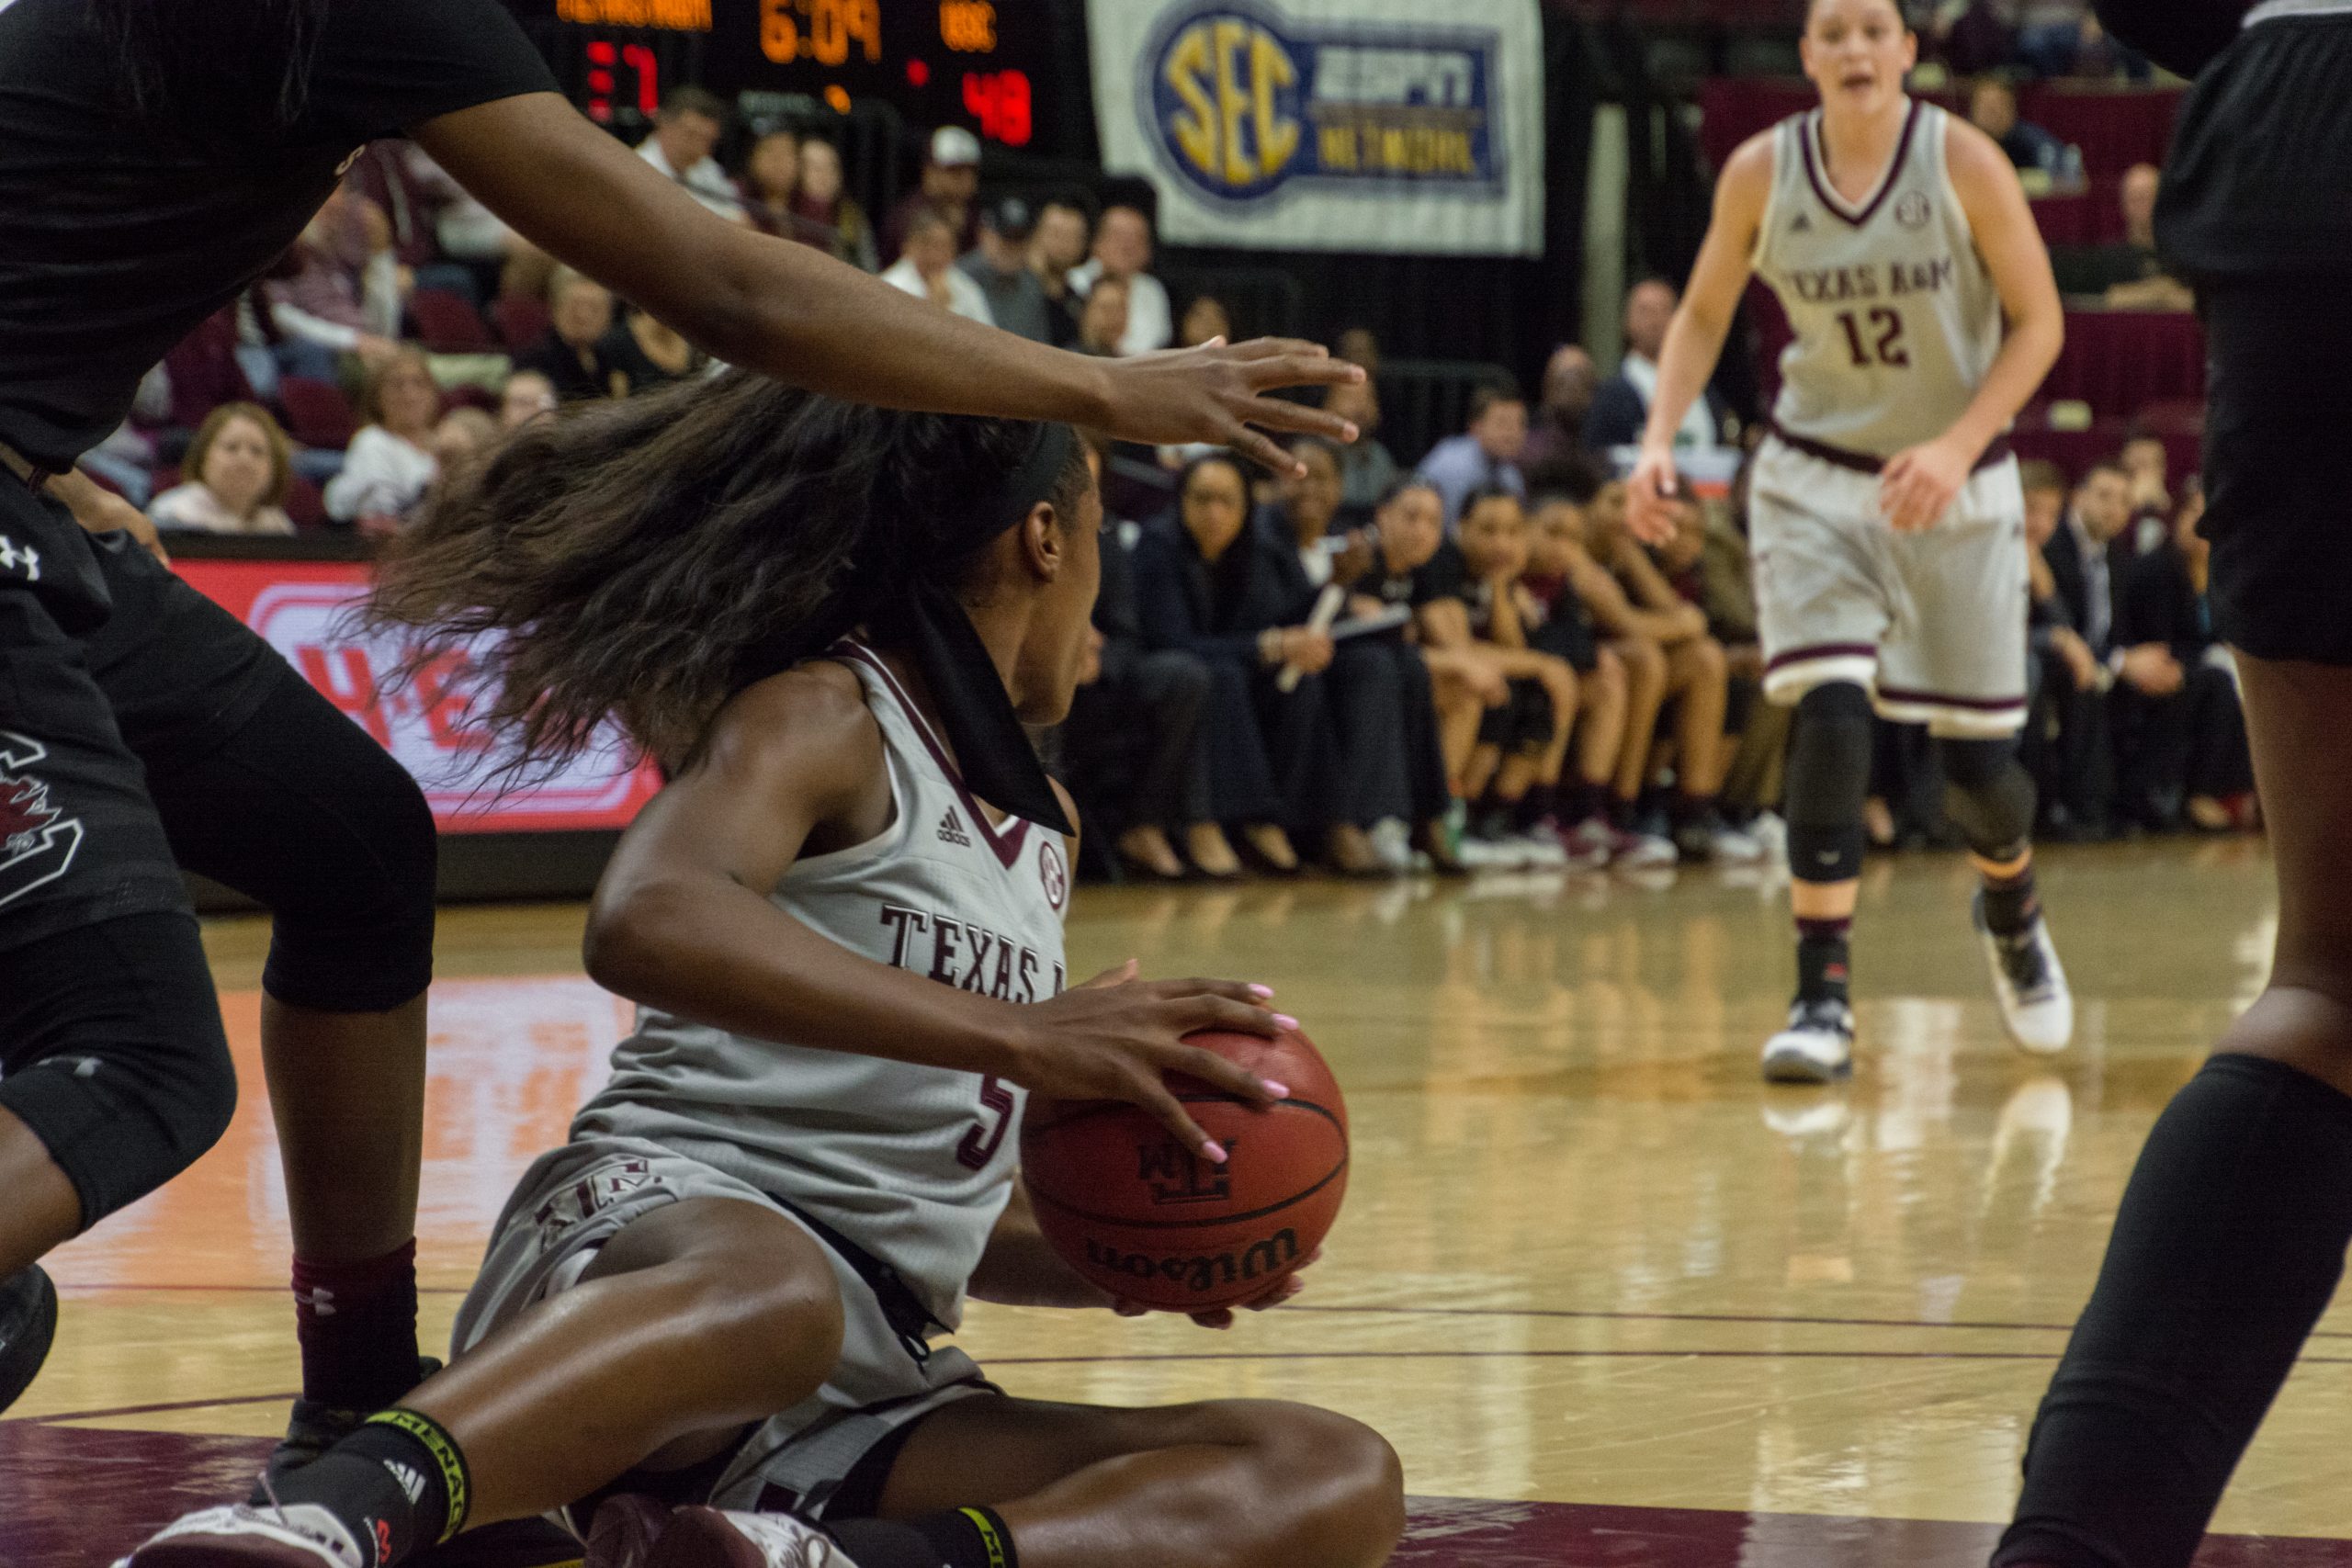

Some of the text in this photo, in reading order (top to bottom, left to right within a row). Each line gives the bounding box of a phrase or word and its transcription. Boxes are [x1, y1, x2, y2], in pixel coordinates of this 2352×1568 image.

[1166, 20, 1299, 186] SEC
[1836, 308, 1911, 368] 12
[937, 829, 971, 848] adidas
[880, 903, 1038, 1004] TEXAS
[956, 1073, 1015, 1171] 5
[1086, 1227, 1299, 1292] Wilson
